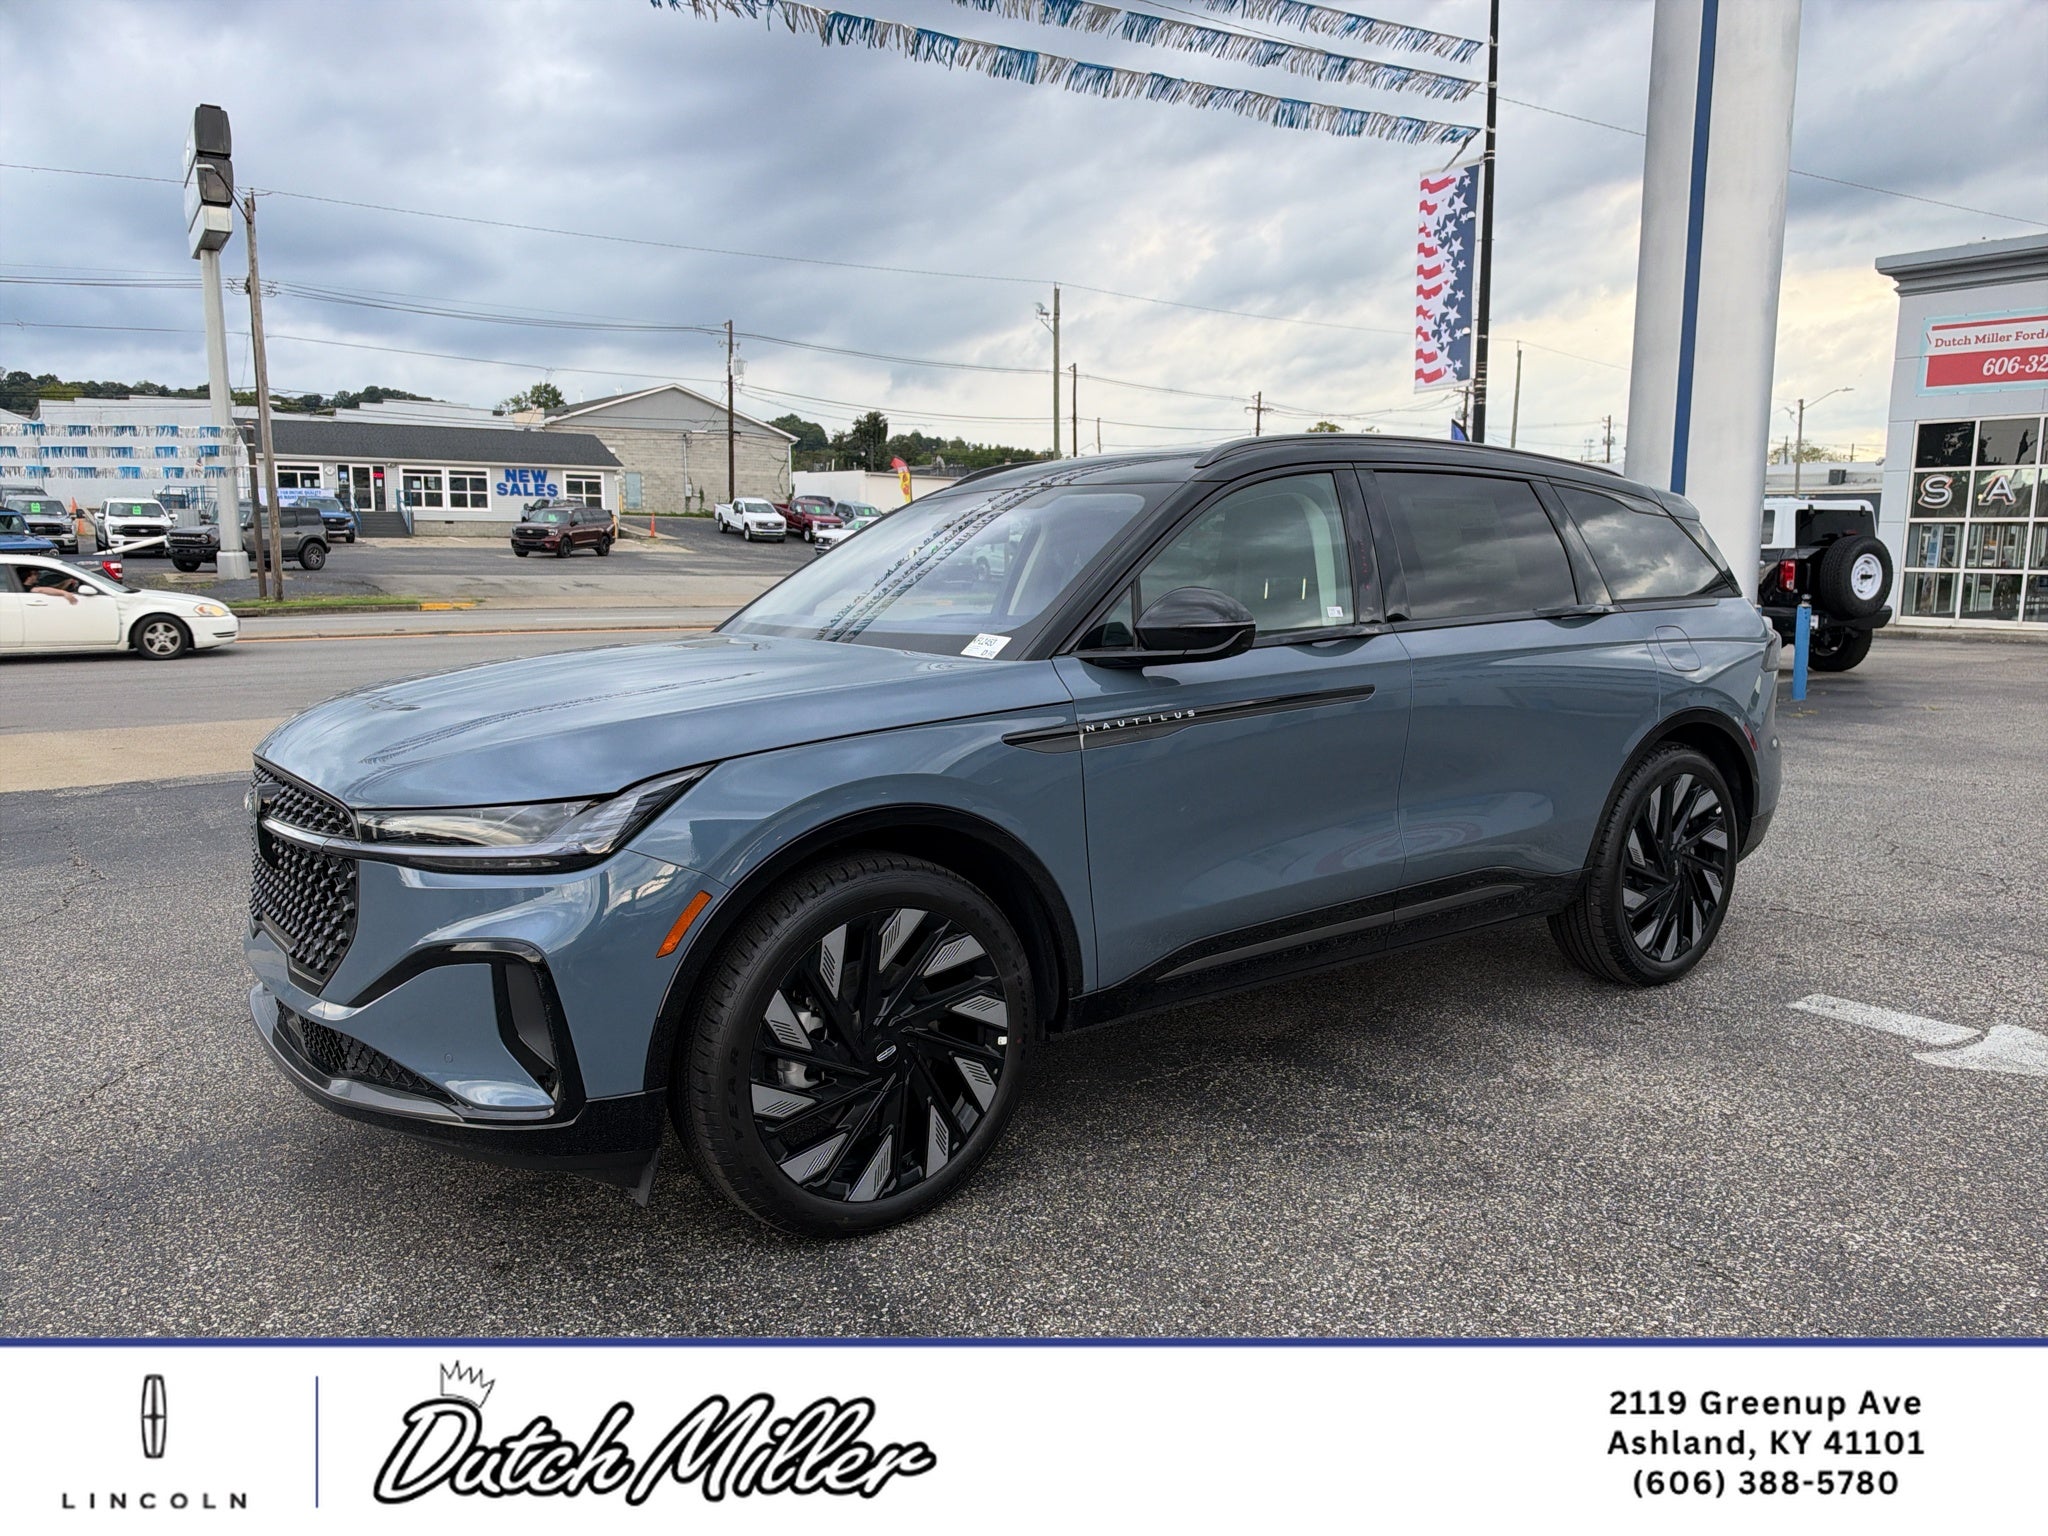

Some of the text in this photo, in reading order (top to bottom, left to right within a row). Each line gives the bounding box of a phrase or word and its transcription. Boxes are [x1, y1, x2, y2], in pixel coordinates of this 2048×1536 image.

[1934, 335, 1972, 348] Dutch
[1974, 332, 2013, 345] Miller
[1982, 353, 2048, 376] 606-32
[504, 469, 548, 483] NEW
[496, 482, 559, 497] SALES
[1085, 709, 1195, 733] NAUTILUS
